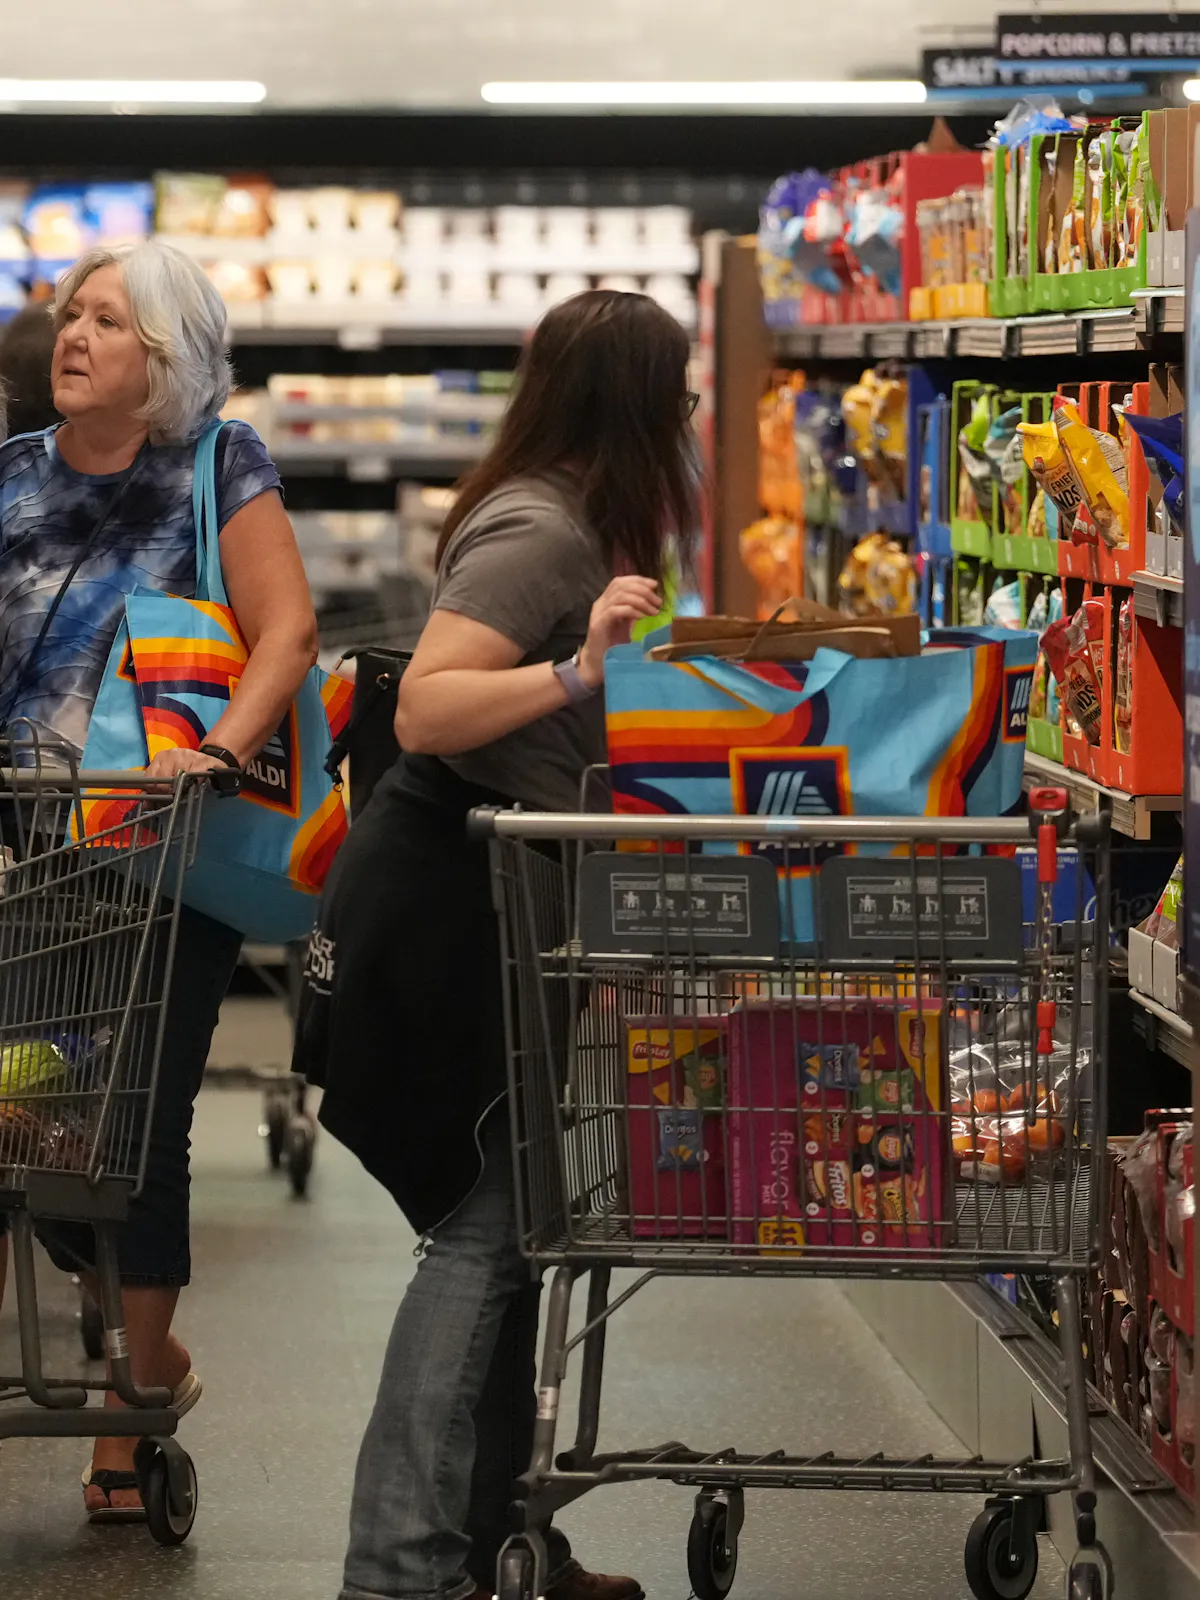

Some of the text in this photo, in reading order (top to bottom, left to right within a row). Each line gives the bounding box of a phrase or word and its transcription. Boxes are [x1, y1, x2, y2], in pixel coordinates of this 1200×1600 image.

[1001, 32, 1105, 58] POPCORN
[1108, 32, 1128, 57] &
[1053, 484, 1082, 510] NDS
[1075, 683, 1098, 713] NDS
[245, 758, 287, 790] ALDI
[770, 1129, 795, 1211] flavor
[828, 1161, 847, 1206] Fritos
[761, 1184, 772, 1205] MIX
